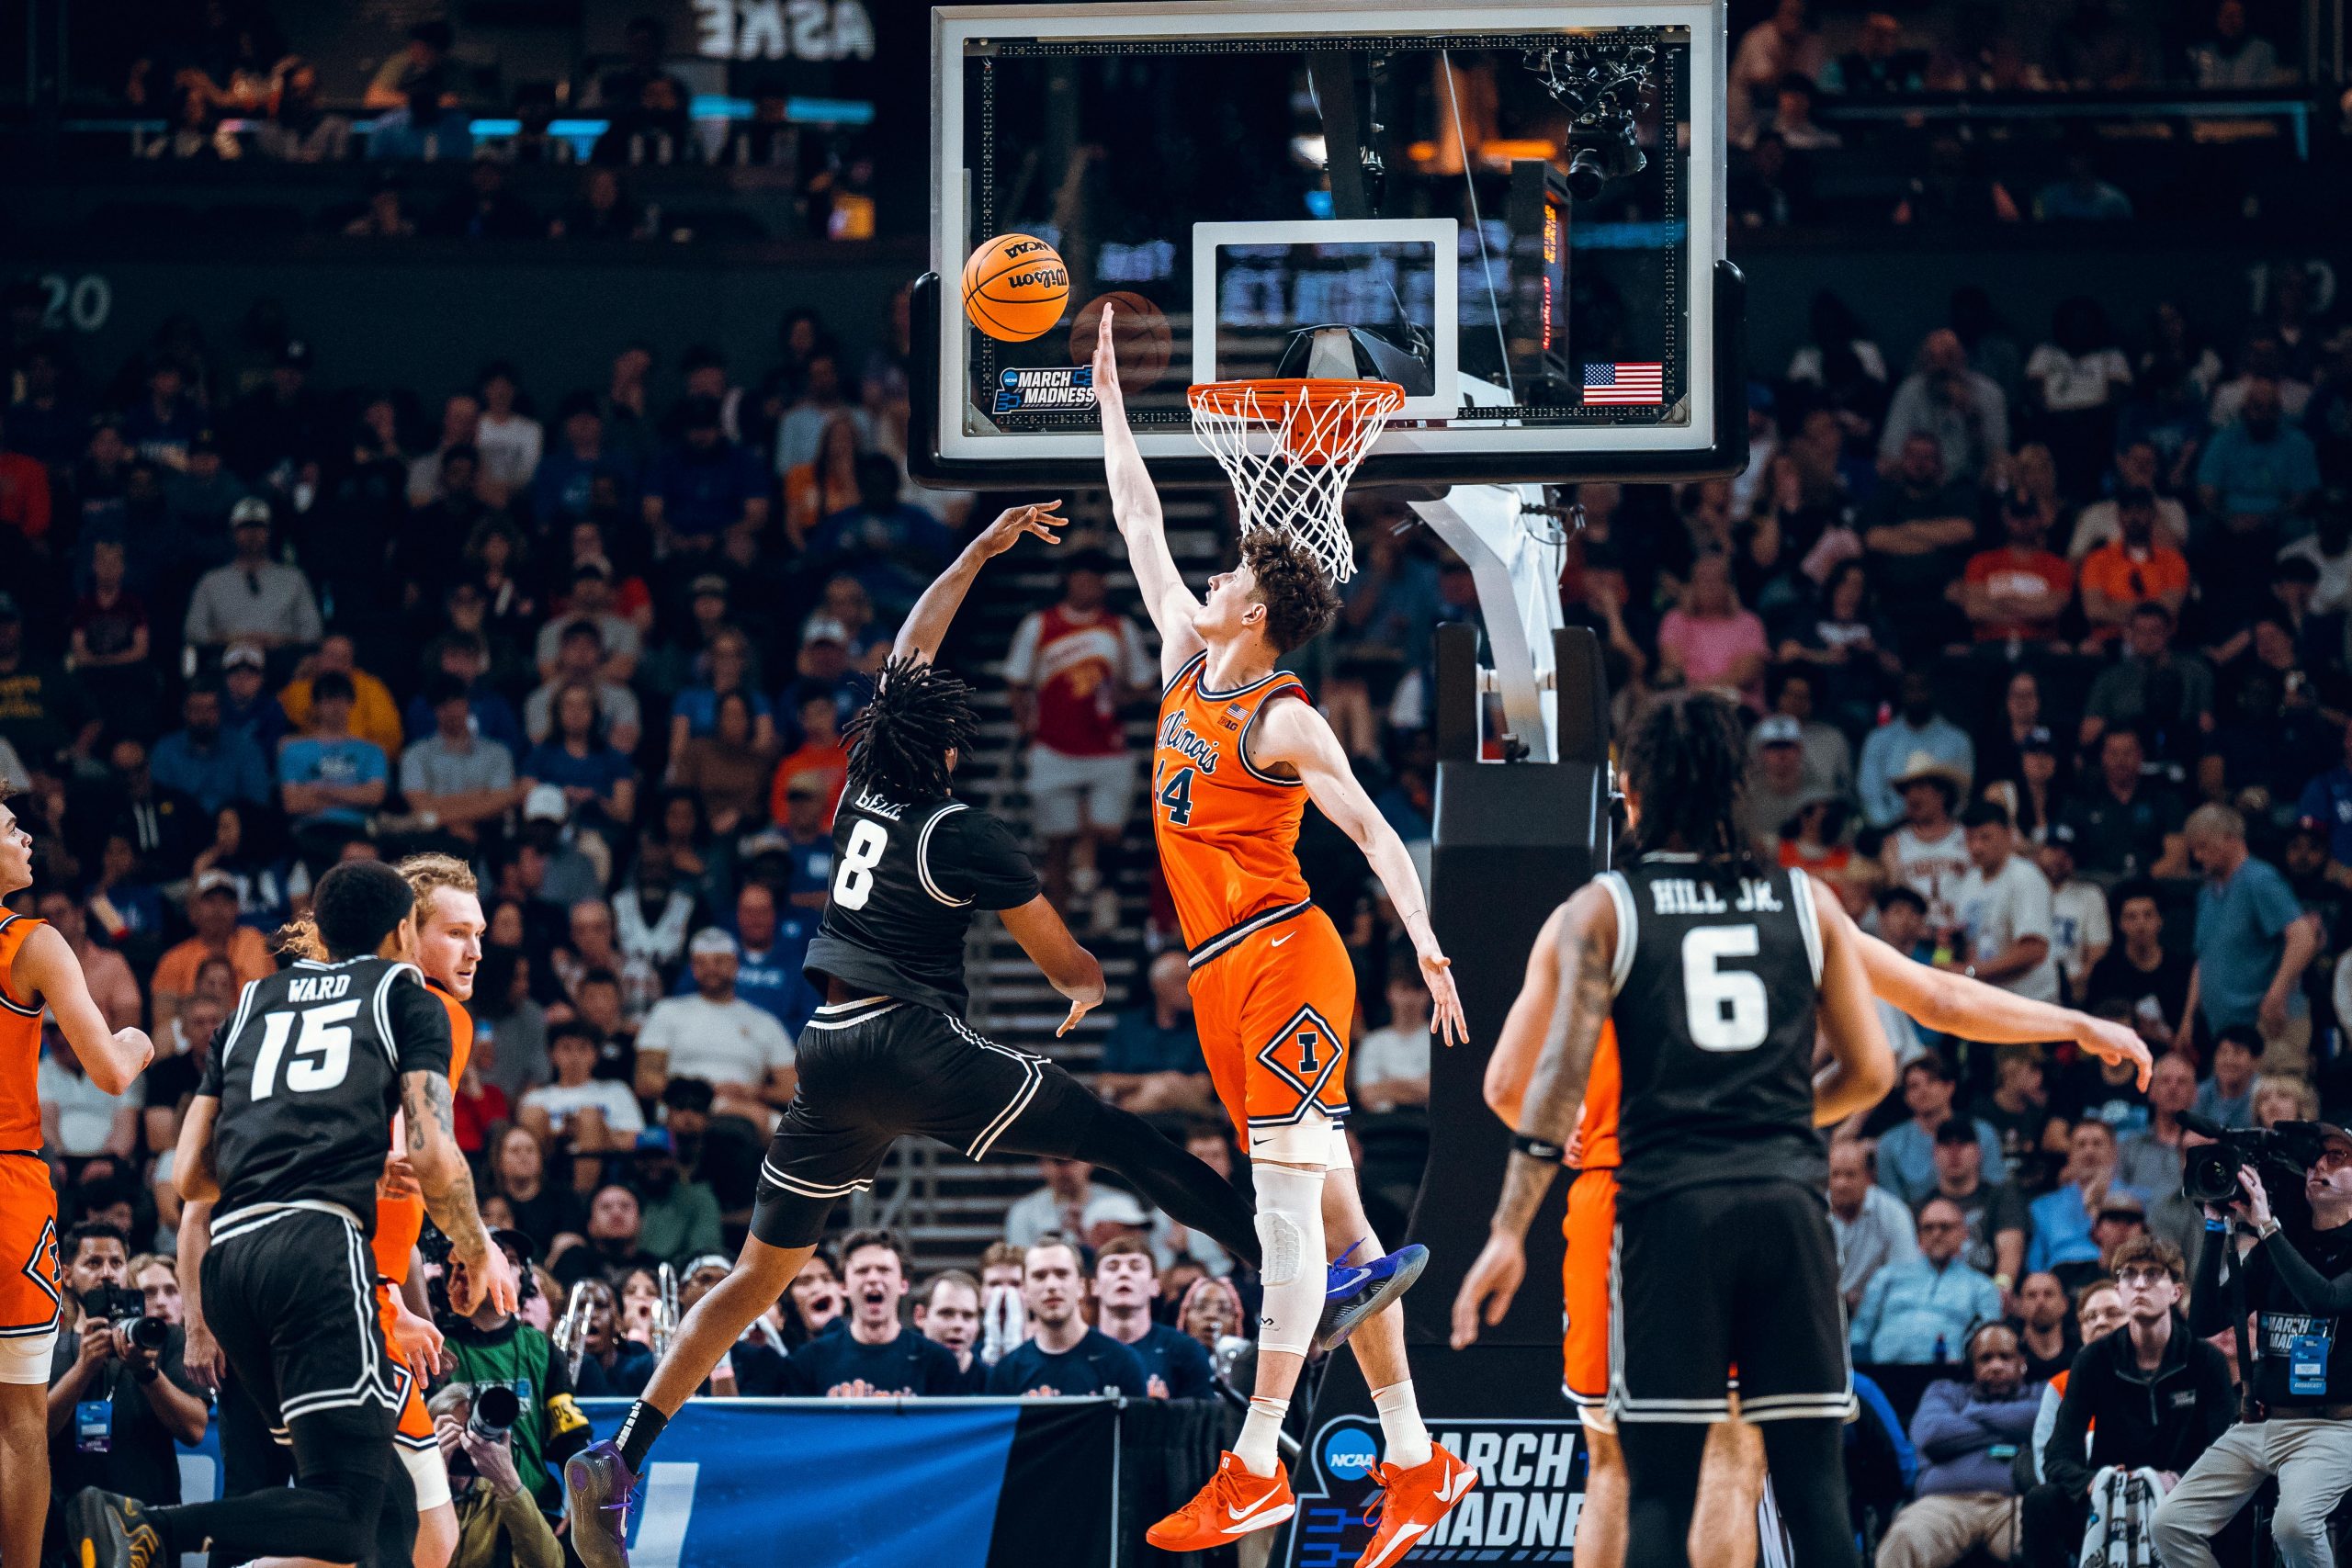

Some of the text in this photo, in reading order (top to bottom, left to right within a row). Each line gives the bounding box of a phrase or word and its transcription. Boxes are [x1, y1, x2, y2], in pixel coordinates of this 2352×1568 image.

[1004, 241, 1051, 260] NCAA
[1008, 266, 1068, 288] Wilson
[1018, 371, 1071, 387] MARCH
[1023, 387, 1095, 404] MADNESS
[1158, 708, 1219, 774] Illinois
[833, 818, 888, 911] 8
[1650, 878, 1727, 915] HILL
[288, 974, 351, 1003] WARD
[1681, 923, 1770, 1052] 6
[251, 998, 362, 1102] 15
[1296, 1031, 1319, 1074] I
[1330, 1453, 1375, 1467] NCAA
[1426, 1432, 1576, 1487] ARCH
